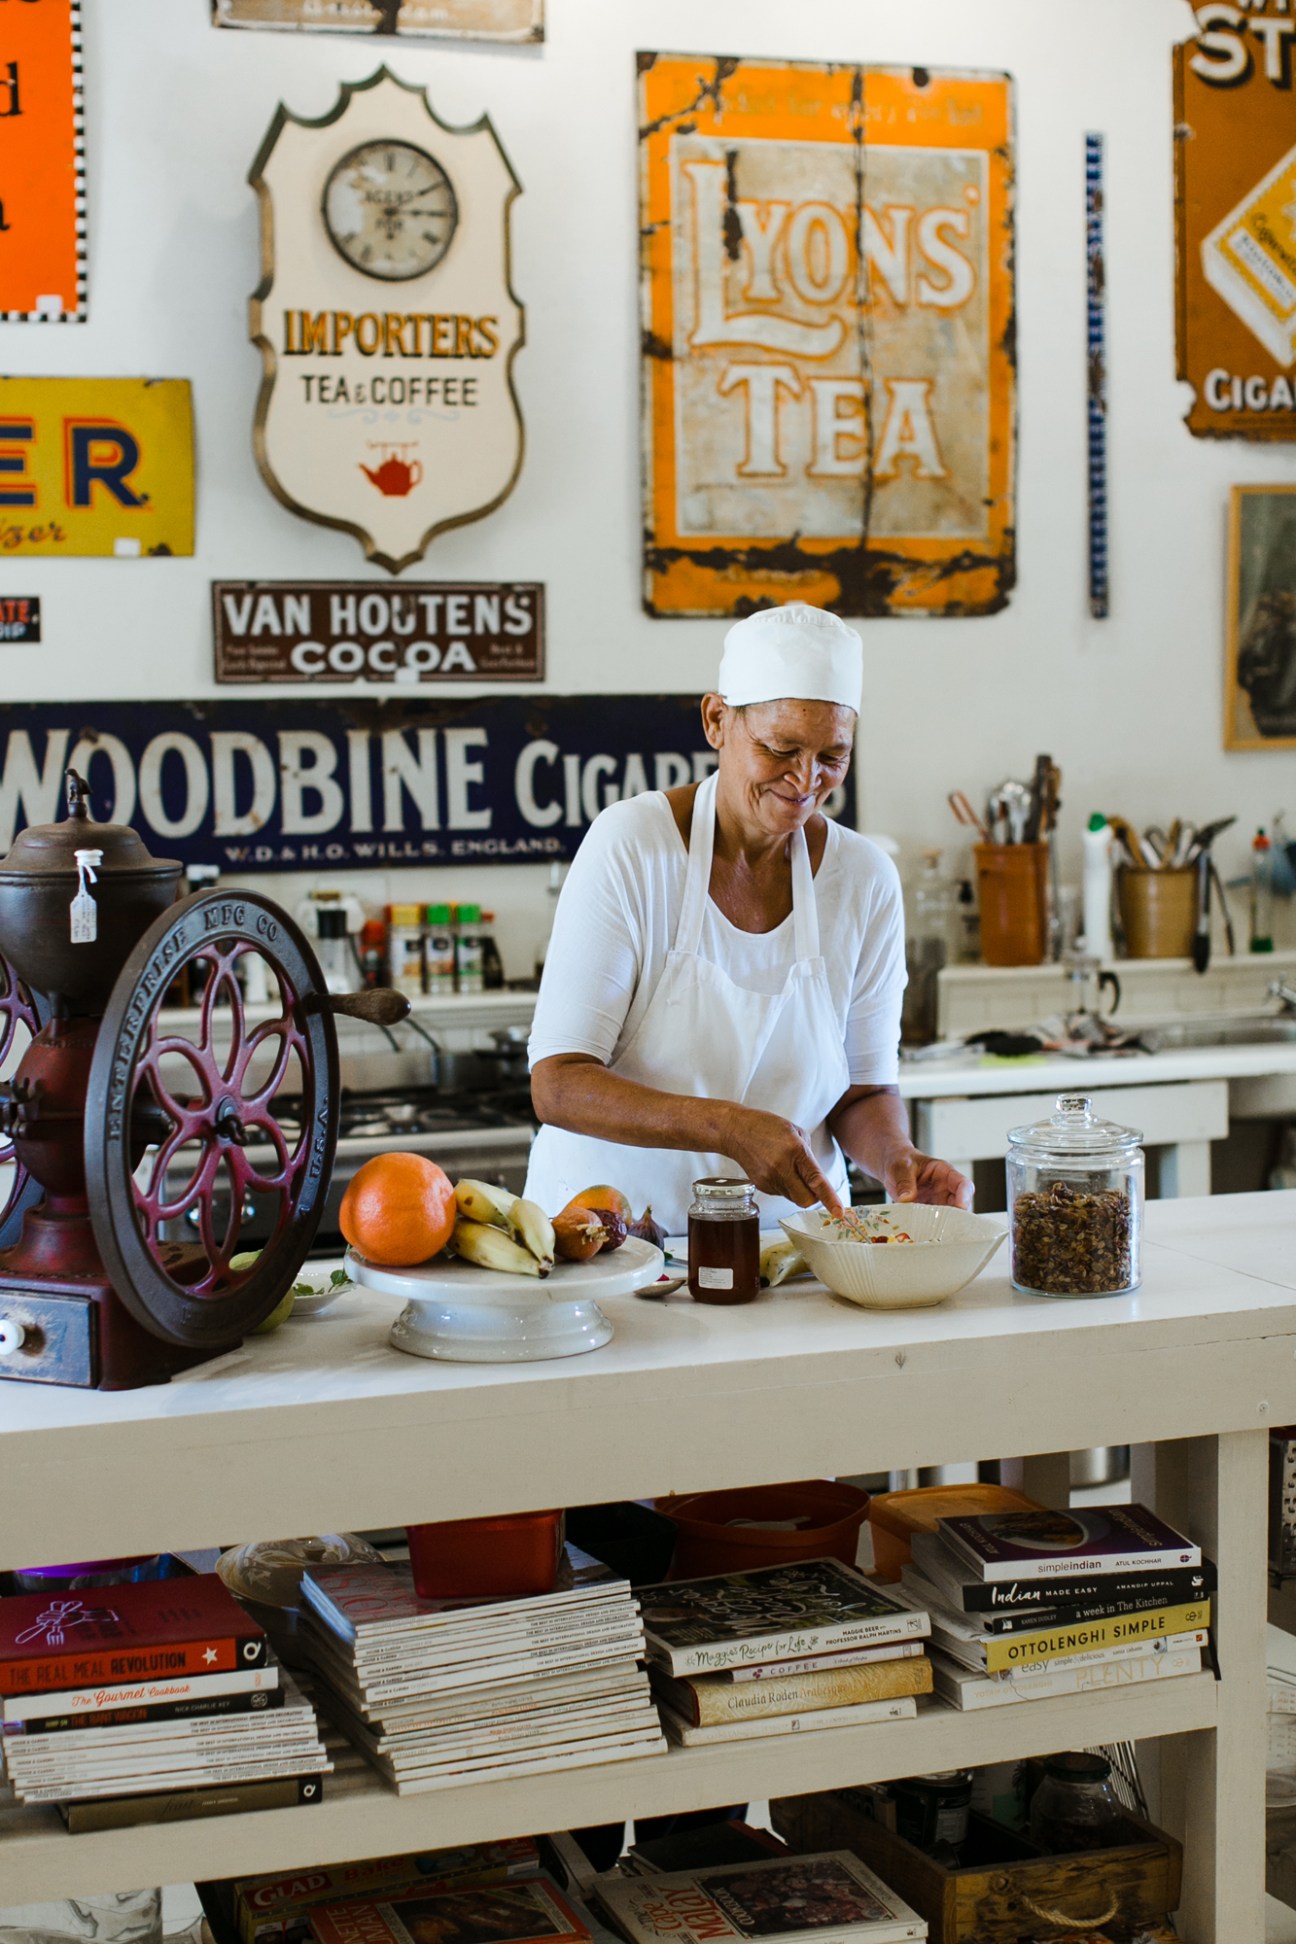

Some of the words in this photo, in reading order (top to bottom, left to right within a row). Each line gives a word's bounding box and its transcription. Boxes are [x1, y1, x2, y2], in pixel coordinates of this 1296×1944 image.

[283, 309, 499, 359] IMPORTERS
[300, 374, 349, 403] TEA
[371, 376, 479, 406] COFFEE
[716, 359, 950, 478] TEA
[223, 594, 311, 636] VAN
[290, 641, 477, 674] COCOA
[0, 727, 493, 851] WOODBINE
[256, 916, 279, 942] CO
[1115, 1559, 1131, 1567] ATUL
[1131, 1557, 1162, 1567] KOCHHAR
[991, 1583, 1041, 1605] Indian
[1045, 1587, 1071, 1597] MADE
[1075, 1586, 1099, 1596] EASY
[1115, 1582, 1150, 1590] AMANDIP
[1151, 1580, 1174, 1588] UPPAL
[1075, 1610, 1082, 1619] a
[1082, 1605, 1106, 1619] week
[1106, 1604, 1116, 1614] in
[1116, 1601, 1134, 1613] The
[1135, 1595, 1168, 1611] Kitchen
[825, 1635, 858, 1646] PROFESSOR
[859, 1632, 877, 1641] RALPH
[877, 1628, 902, 1638] MARTINS
[842, 1628, 863, 1637] MAGGIE
[864, 1626, 880, 1634] BEER
[1008, 1628, 1106, 1660] OTTOLENGHI
[1113, 1616, 1166, 1638] SIMPLE
[695, 1646, 738, 1667] Maggie's
[739, 1642, 774, 1660] Recipe
[775, 1640, 786, 1656] for
[1021, 1657, 1050, 1672] easy
[10, 1667, 30, 1686] THE
[36, 1663, 68, 1684] REAL
[74, 1660, 105, 1681] MEAL
[111, 1652, 187, 1676] REVOLUTION
[770, 1662, 819, 1675] COFFEE
[1075, 1656, 1164, 1687] PLENTY
[72, 1696, 92, 1707] The
[94, 1687, 146, 1707] Gourmet
[147, 1684, 191, 1699] Cookbook
[175, 1705, 190, 1713] NICK
[190, 1702, 217, 1712] CHARLIE
[218, 1701, 231, 1709] KEY
[727, 1692, 767, 1710] Claudia
[768, 1690, 799, 1704] Roden
[253, 1875, 326, 1907] GLAD
[344, 1856, 405, 1881] Bake
